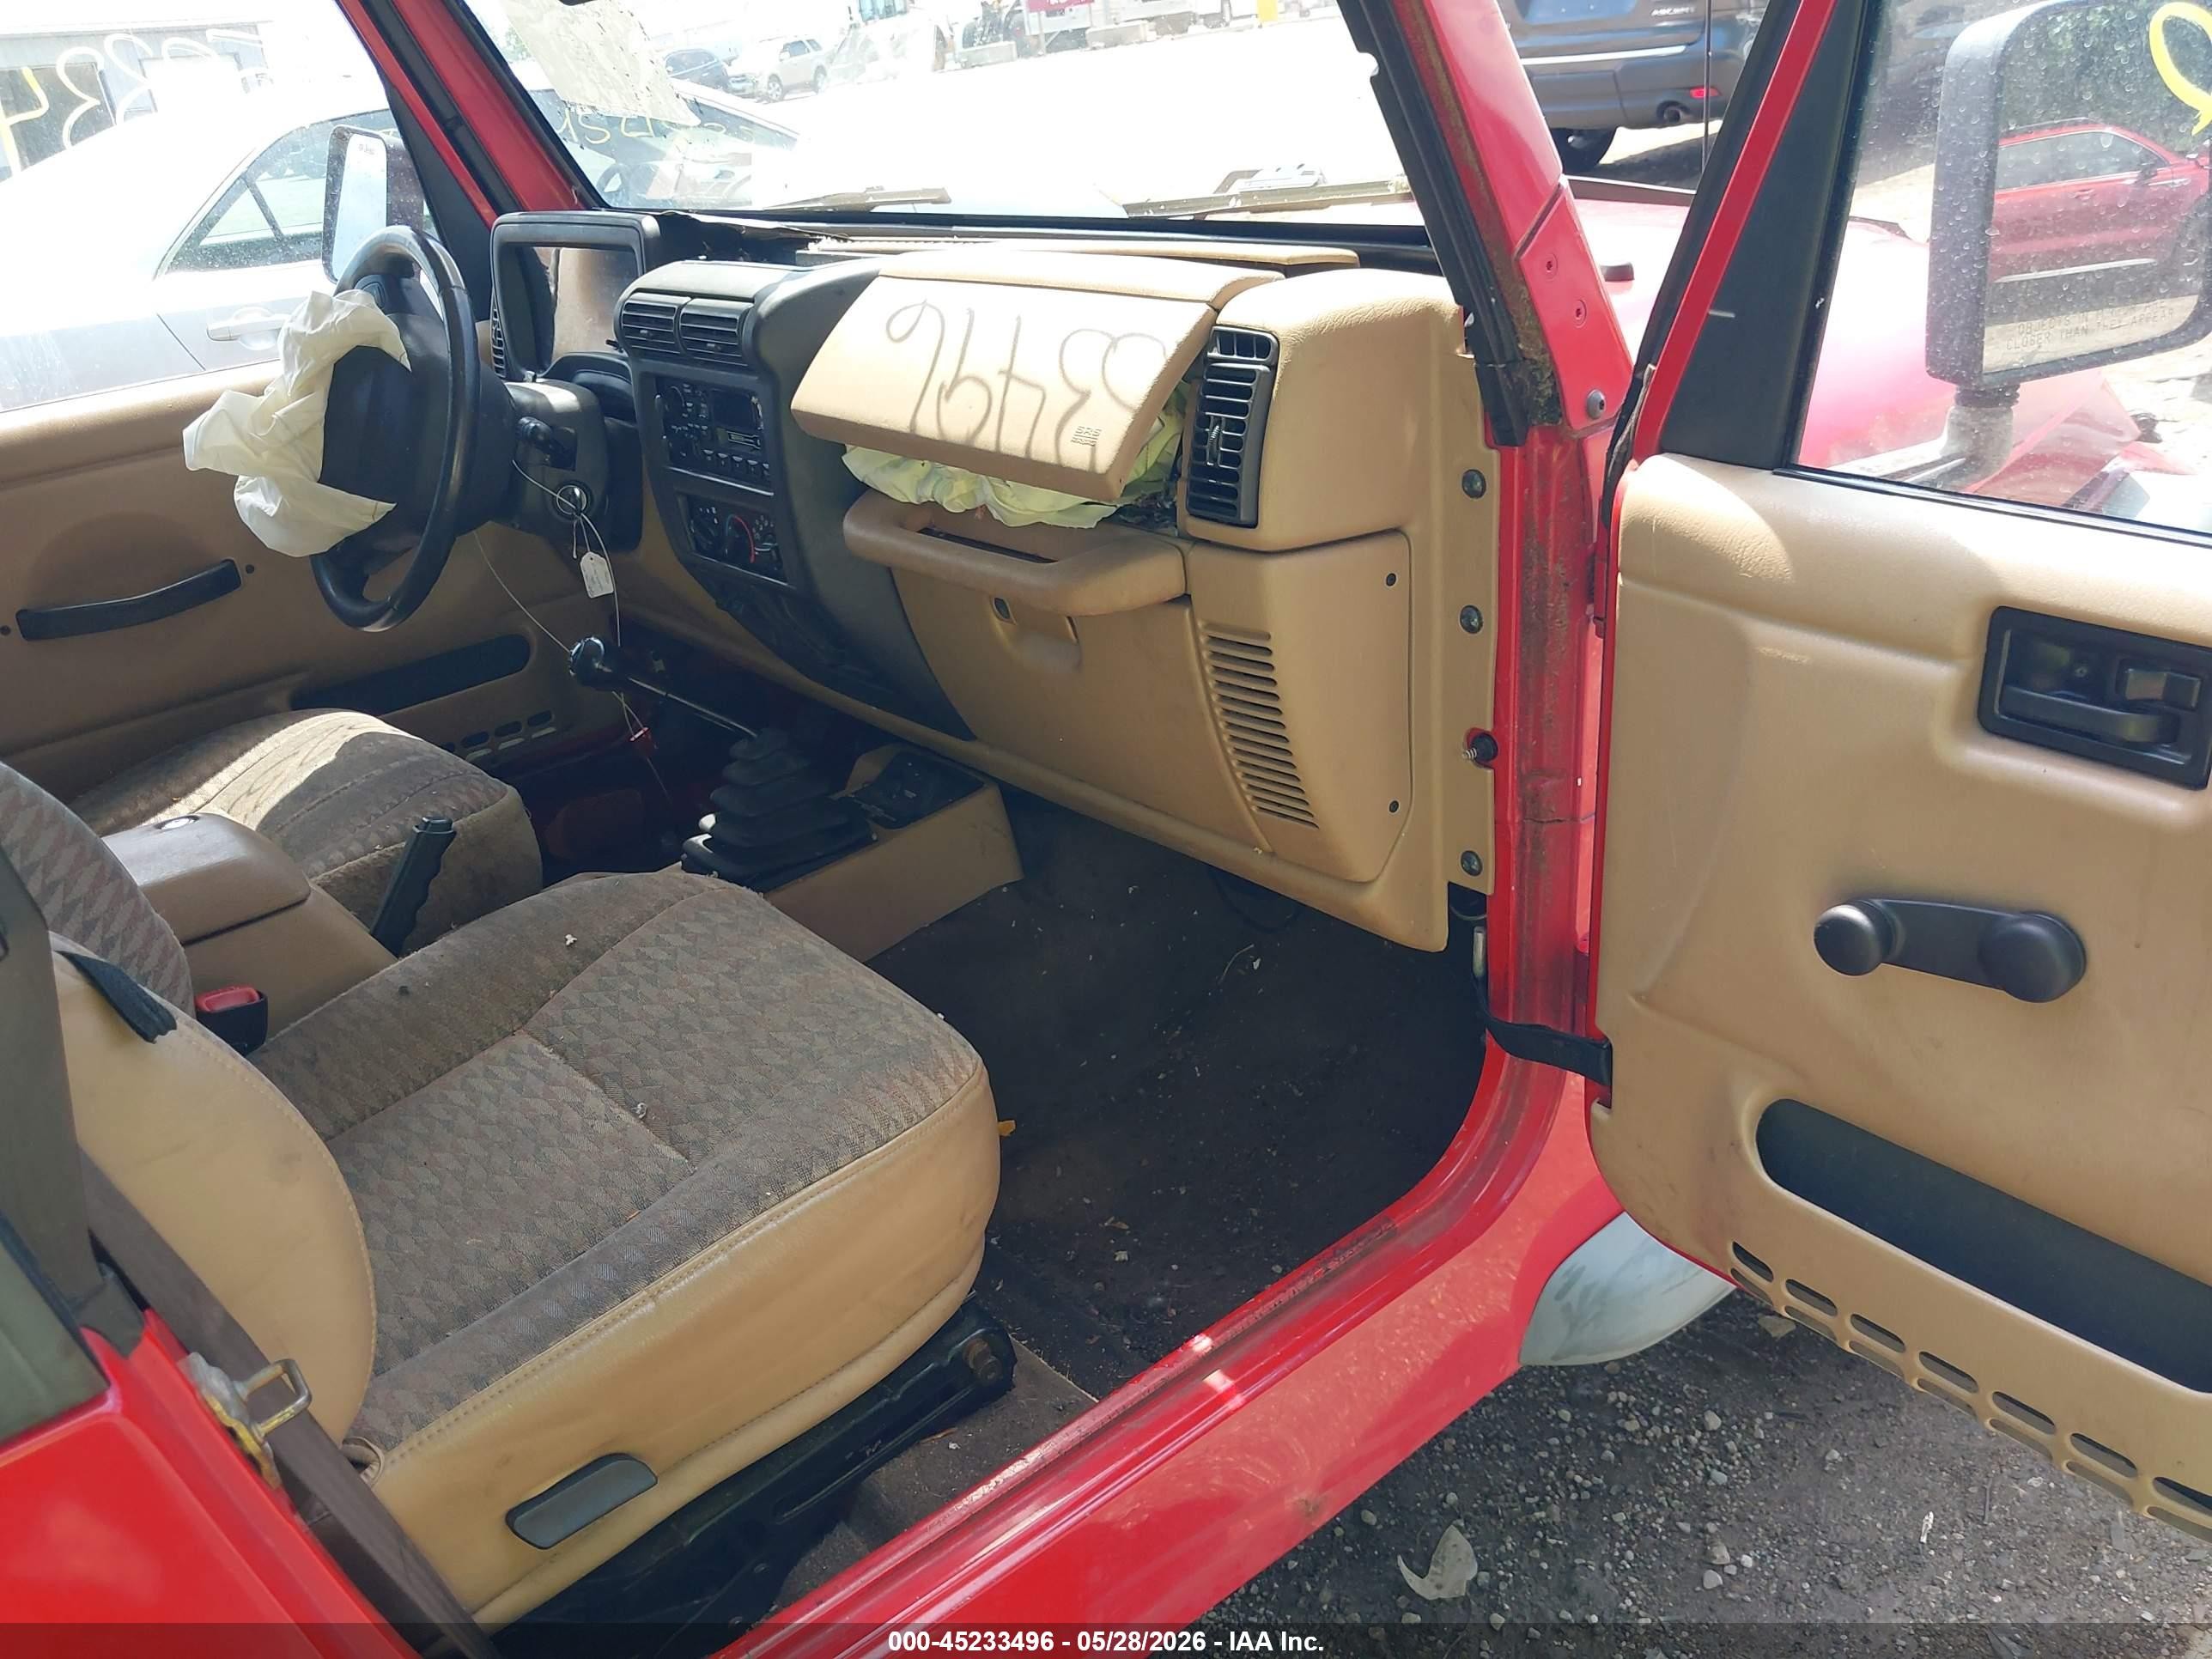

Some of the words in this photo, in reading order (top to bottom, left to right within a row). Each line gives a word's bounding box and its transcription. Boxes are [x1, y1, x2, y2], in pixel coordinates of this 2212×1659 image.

[2017, 315, 2071, 336] OBJECTS
[2006, 331, 2051, 350] CLOSER
[2060, 325, 2089, 340] THAN
